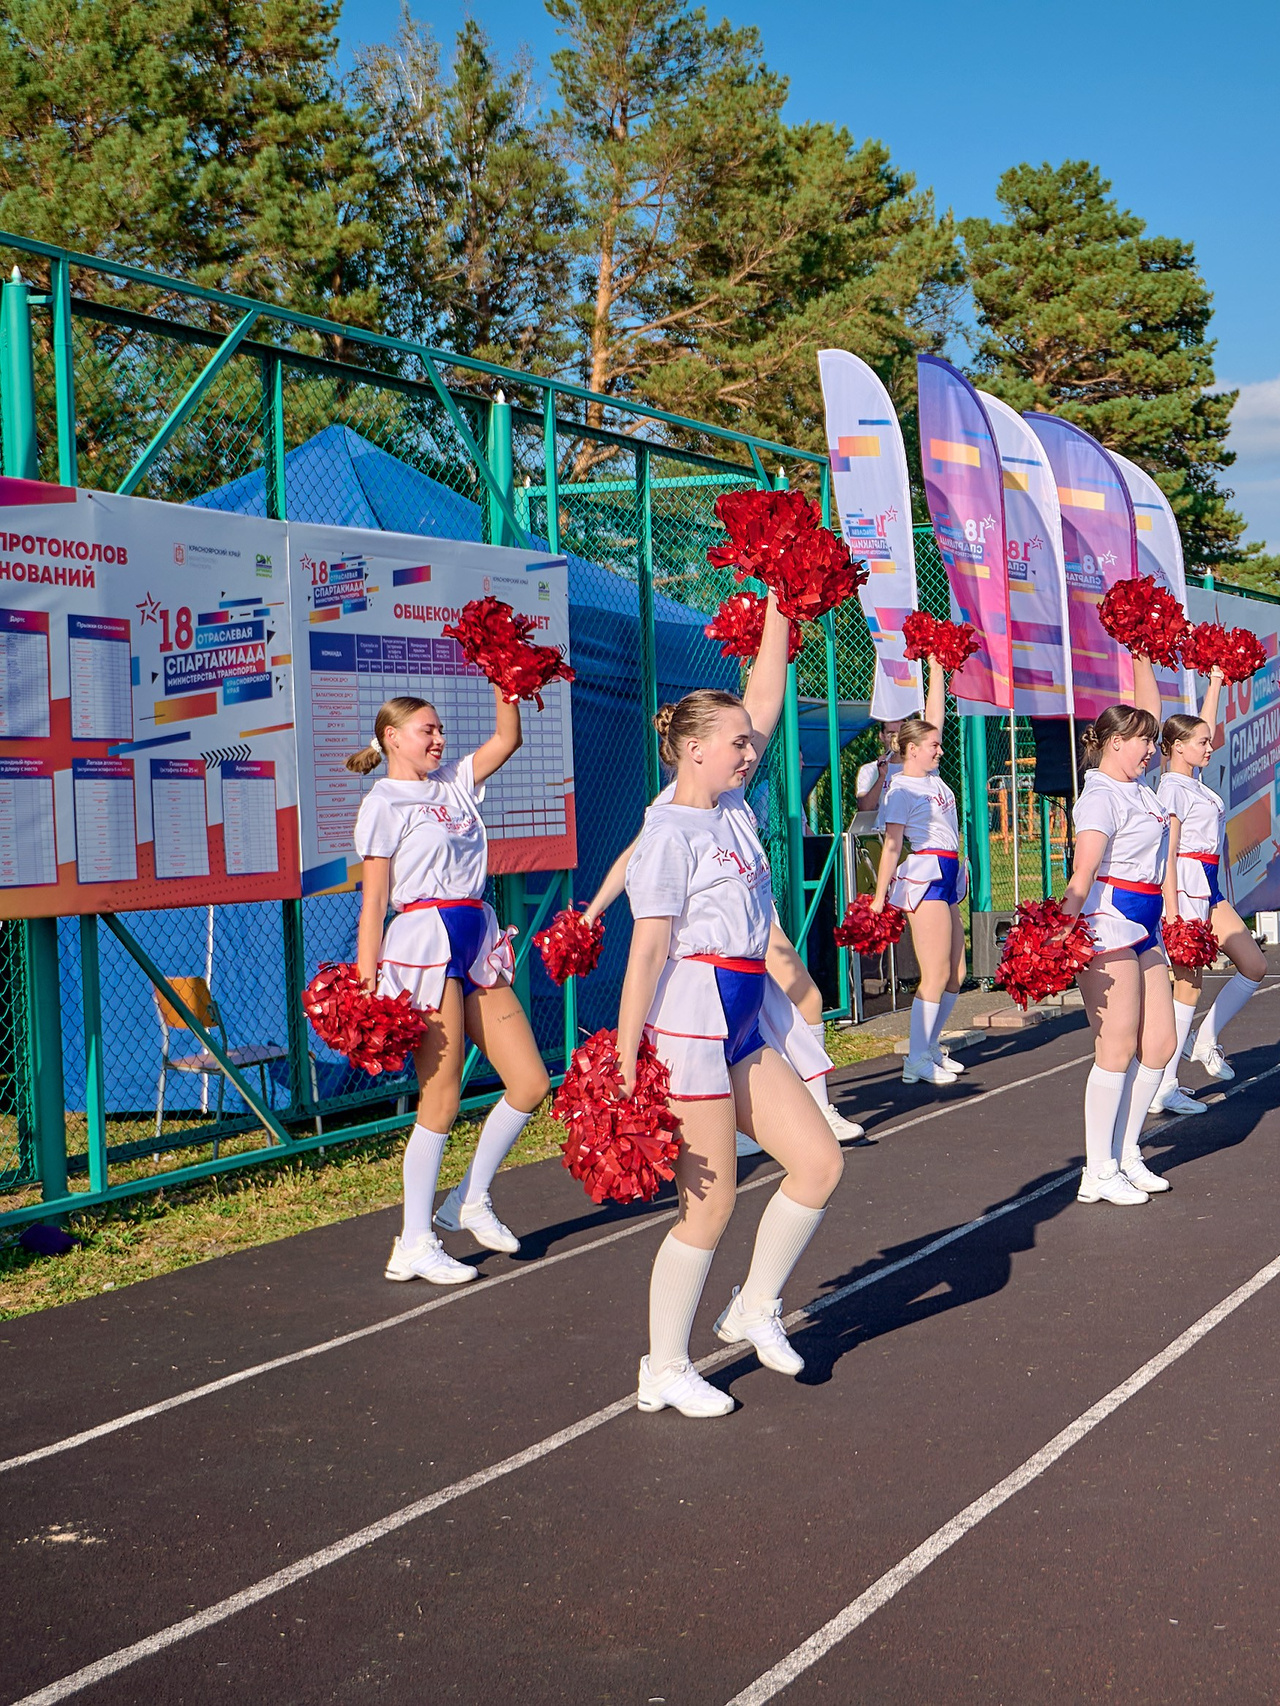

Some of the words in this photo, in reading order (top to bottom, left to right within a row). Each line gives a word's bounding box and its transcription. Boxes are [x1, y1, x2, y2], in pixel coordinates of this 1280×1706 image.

[311, 560, 328, 585] 18
[330, 571, 358, 582] ОТРАСЛЕВАЯ
[315, 581, 364, 598] СПАРТАКИАДА
[393, 603, 460, 623] ОБЩЕКОМ
[160, 606, 193, 653] 18
[197, 627, 253, 645] ОТРАСЛЕВАЯ
[166, 644, 265, 676] СПАРТАКИАДА
[167, 671, 216, 687] МИНИСТЕРСТВА
[217, 665, 257, 679] ТРАНСПОРТА
[227, 674, 270, 687] КРАСНОЯРСКОГО
[227, 686, 240, 694] КРАЯ
[1231, 756, 1269, 791] МИНИСТЕРСТВА
[431, 805, 452, 823] 18
